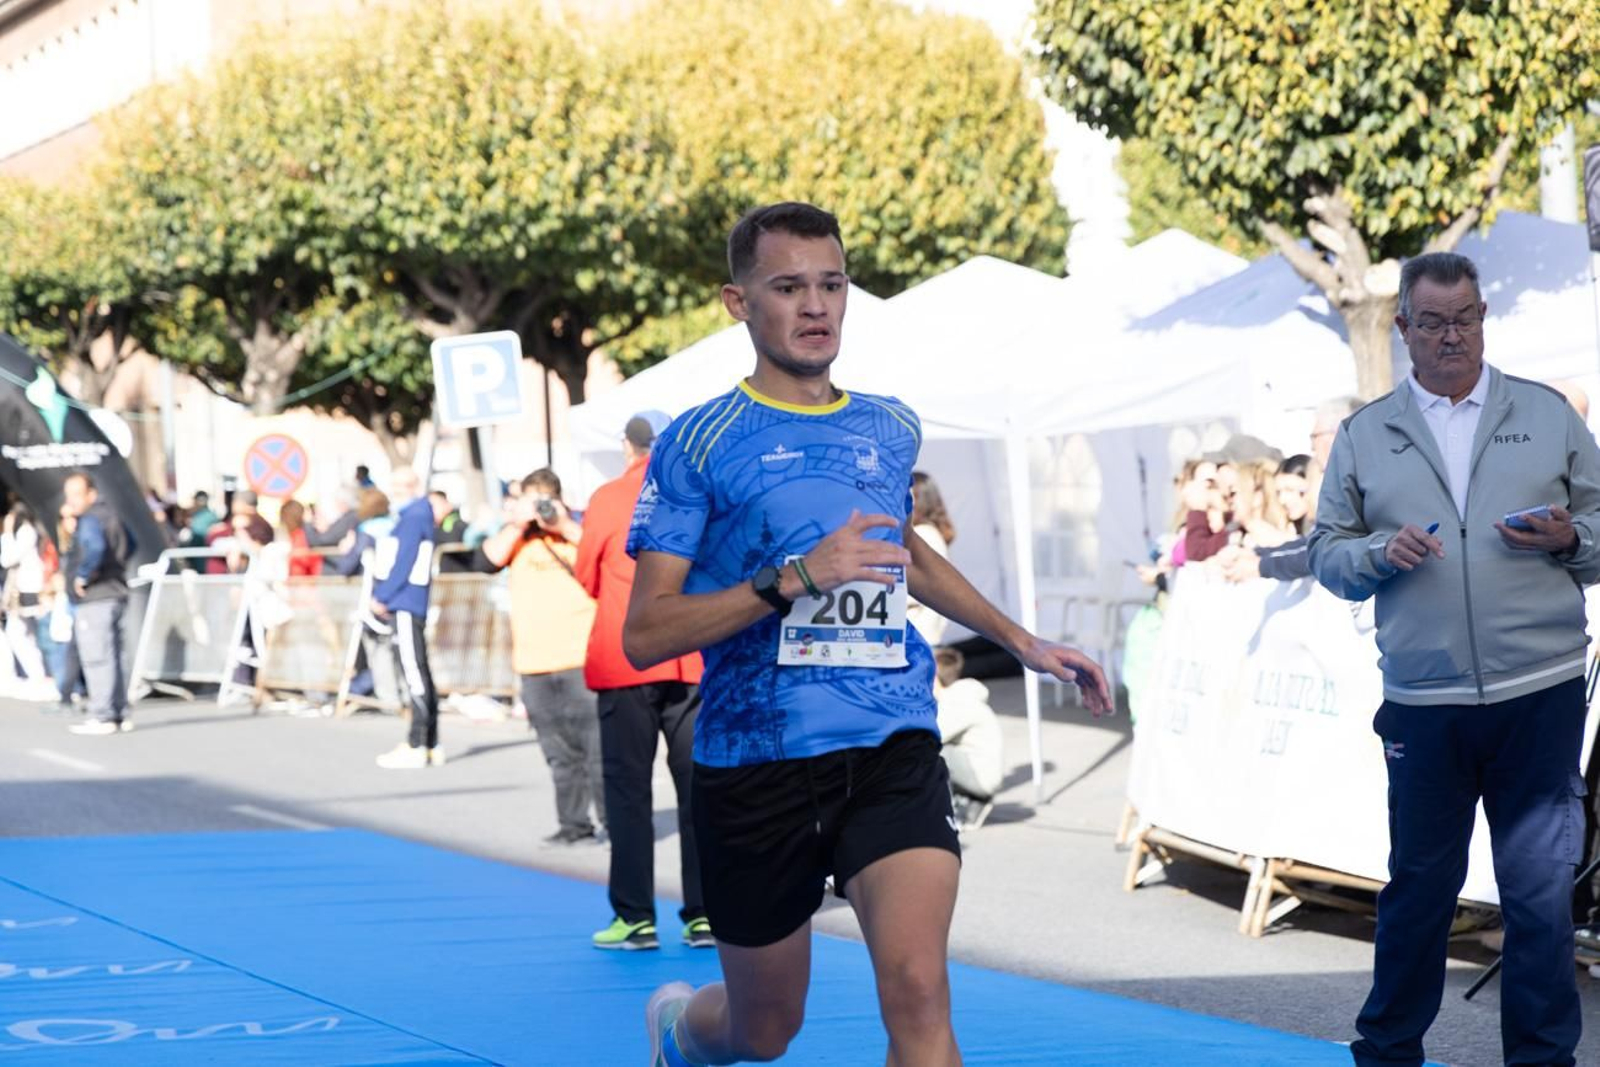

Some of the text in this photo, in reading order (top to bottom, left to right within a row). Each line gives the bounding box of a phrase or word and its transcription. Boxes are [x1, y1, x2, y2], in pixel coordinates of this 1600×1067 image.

[450, 344, 506, 416] P
[811, 590, 888, 625] 204
[838, 629, 865, 638] DAVID
